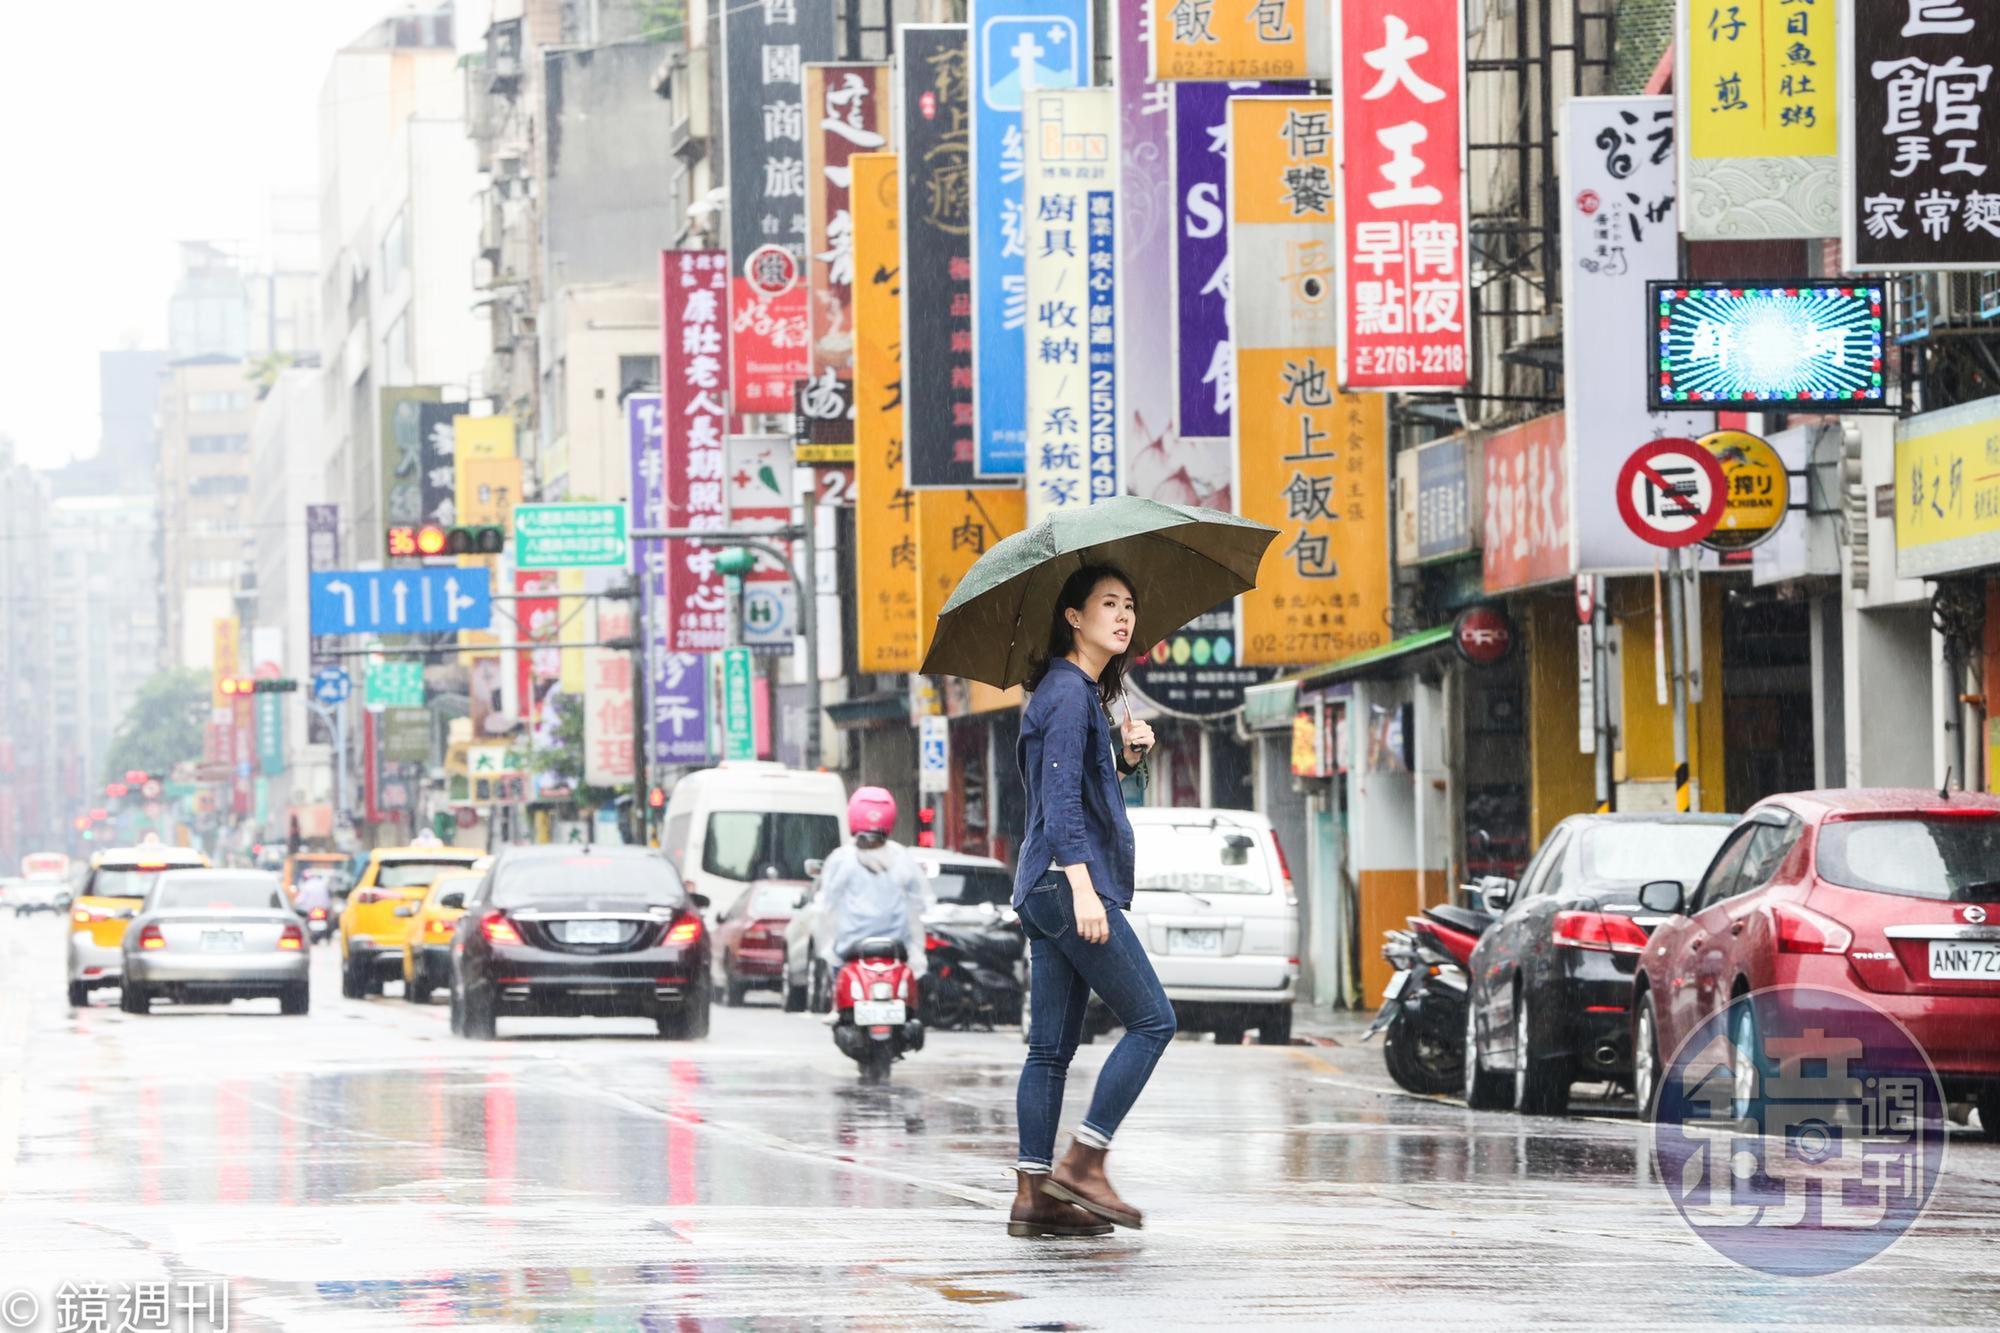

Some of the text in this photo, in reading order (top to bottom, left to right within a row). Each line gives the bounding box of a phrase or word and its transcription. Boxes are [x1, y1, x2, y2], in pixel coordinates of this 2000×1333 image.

[1170, 0, 1293, 41] 飯包
[1708, 6, 1748, 112] 仔煎
[1780, 0, 1817, 128] 目魚肚粥
[1361, 14, 1447, 209] 大王
[1890, 136, 1987, 177] 手工
[1862, 188, 2000, 242] 家常麵
[1354, 221, 1405, 335] 早點
[1411, 220, 1462, 333] 宵夜
[1374, 344, 1463, 375] 2761-2218
[1090, 371, 1116, 502] 252849
[1281, 359, 1338, 578] 池上飯包
[1727, 475, 1773, 495] 搾り
